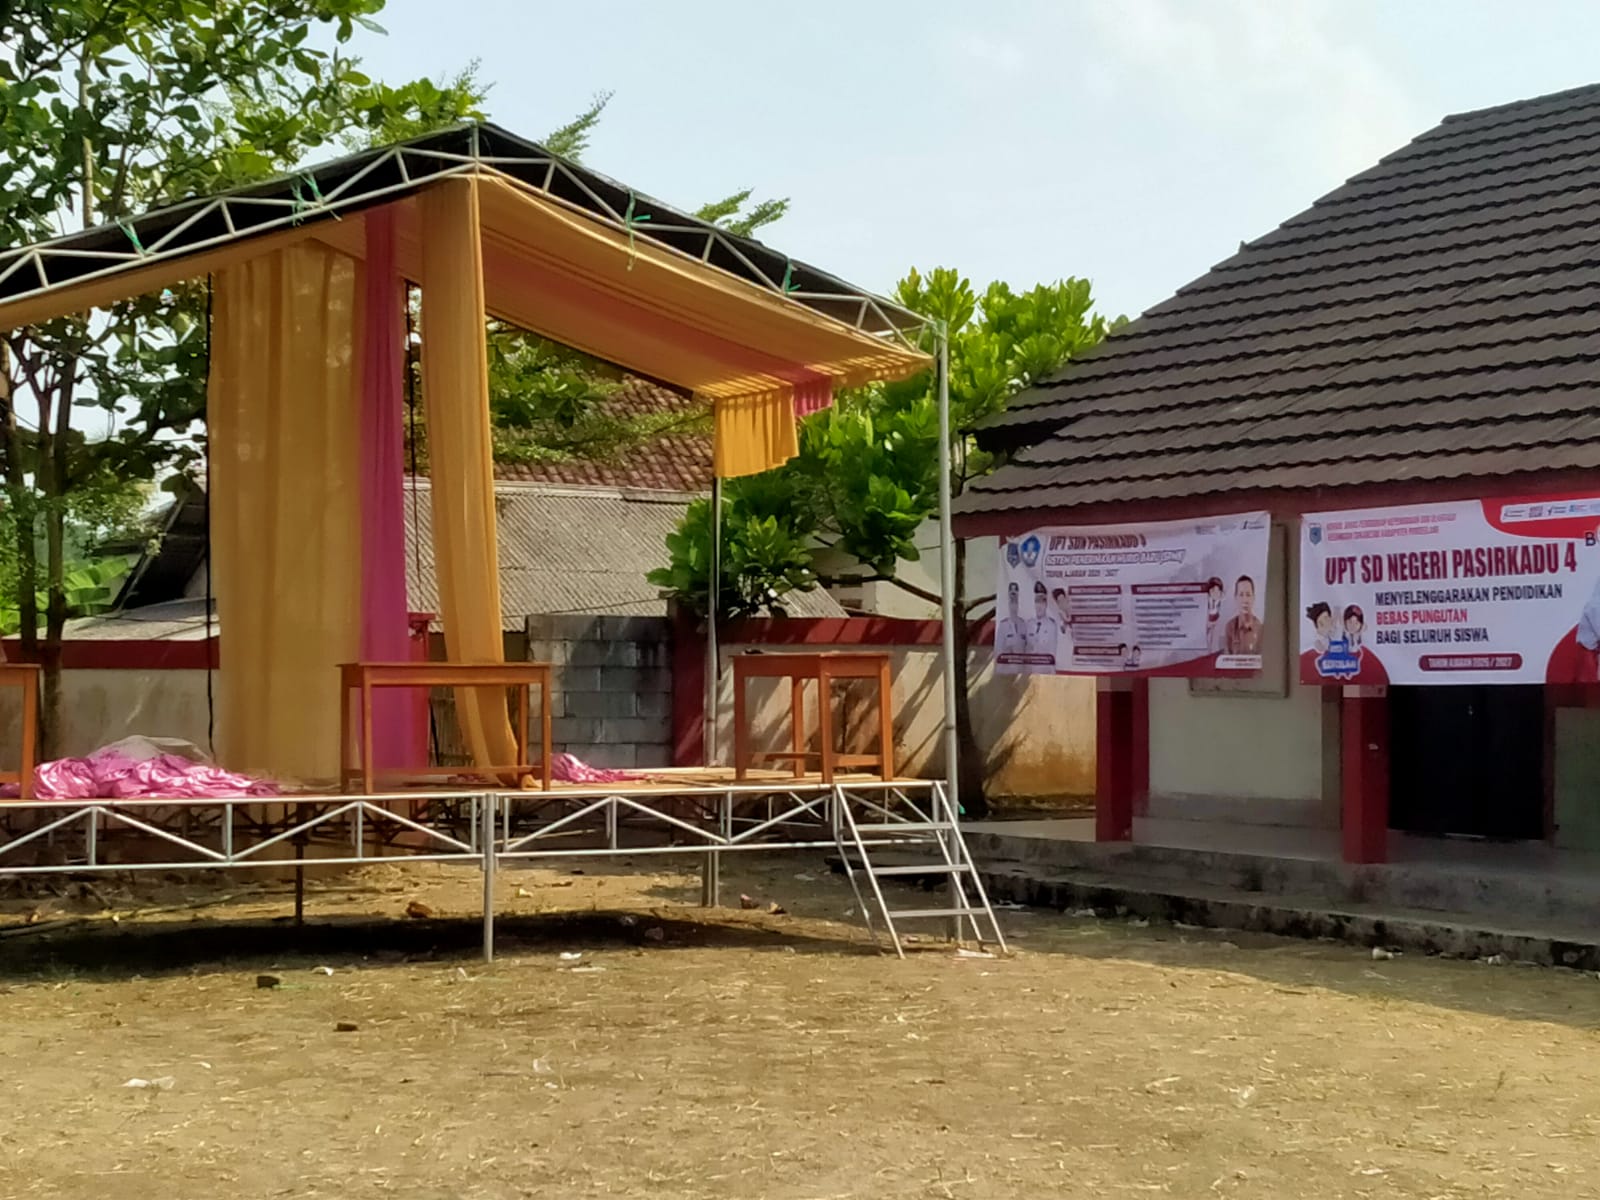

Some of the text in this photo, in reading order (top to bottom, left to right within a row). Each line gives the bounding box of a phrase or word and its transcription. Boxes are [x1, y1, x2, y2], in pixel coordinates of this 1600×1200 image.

[1325, 541, 1577, 585] UPT SD NEGERI PASIRKADU 4
[1375, 584, 1563, 606] MENYELENGGARAKAN PENDIDIKAN
[1376, 608, 1468, 625] BEBAS PUNGUTAN
[1376, 627, 1489, 645] BAGI SELURUH SISWA
